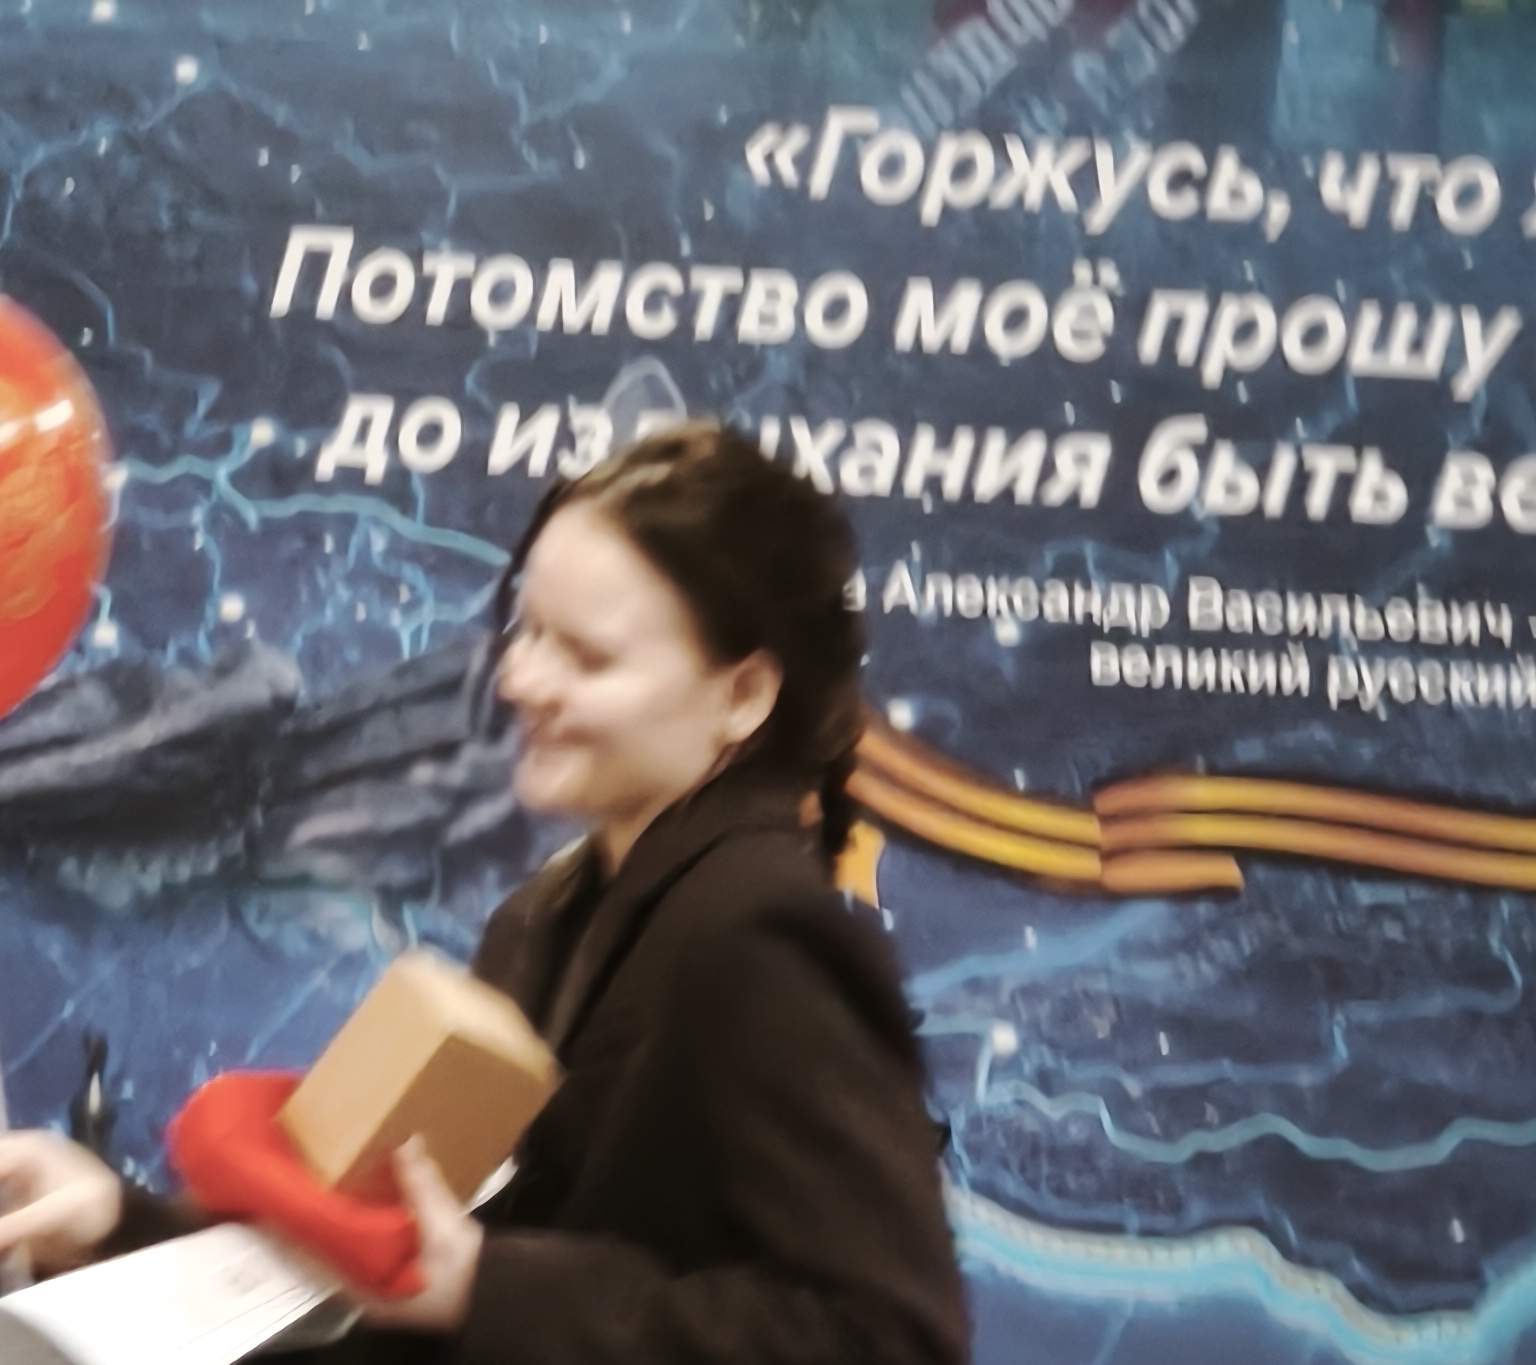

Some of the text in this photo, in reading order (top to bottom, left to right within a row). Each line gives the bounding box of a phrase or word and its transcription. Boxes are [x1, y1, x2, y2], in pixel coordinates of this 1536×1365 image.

[745, 104, 1291, 242] «Горжусь,
[1317, 150, 1502, 236] что
[270, 223, 1522, 402] Потомство моё прошу
[313, 390, 463, 486] до
[486, 398, 1111, 510] изхания
[1137, 414, 1410, 525] быть
[882, 558, 1171, 638] Александр
[1187, 574, 1514, 649] Васильевич
[1089, 640, 1536, 722] великий русский
